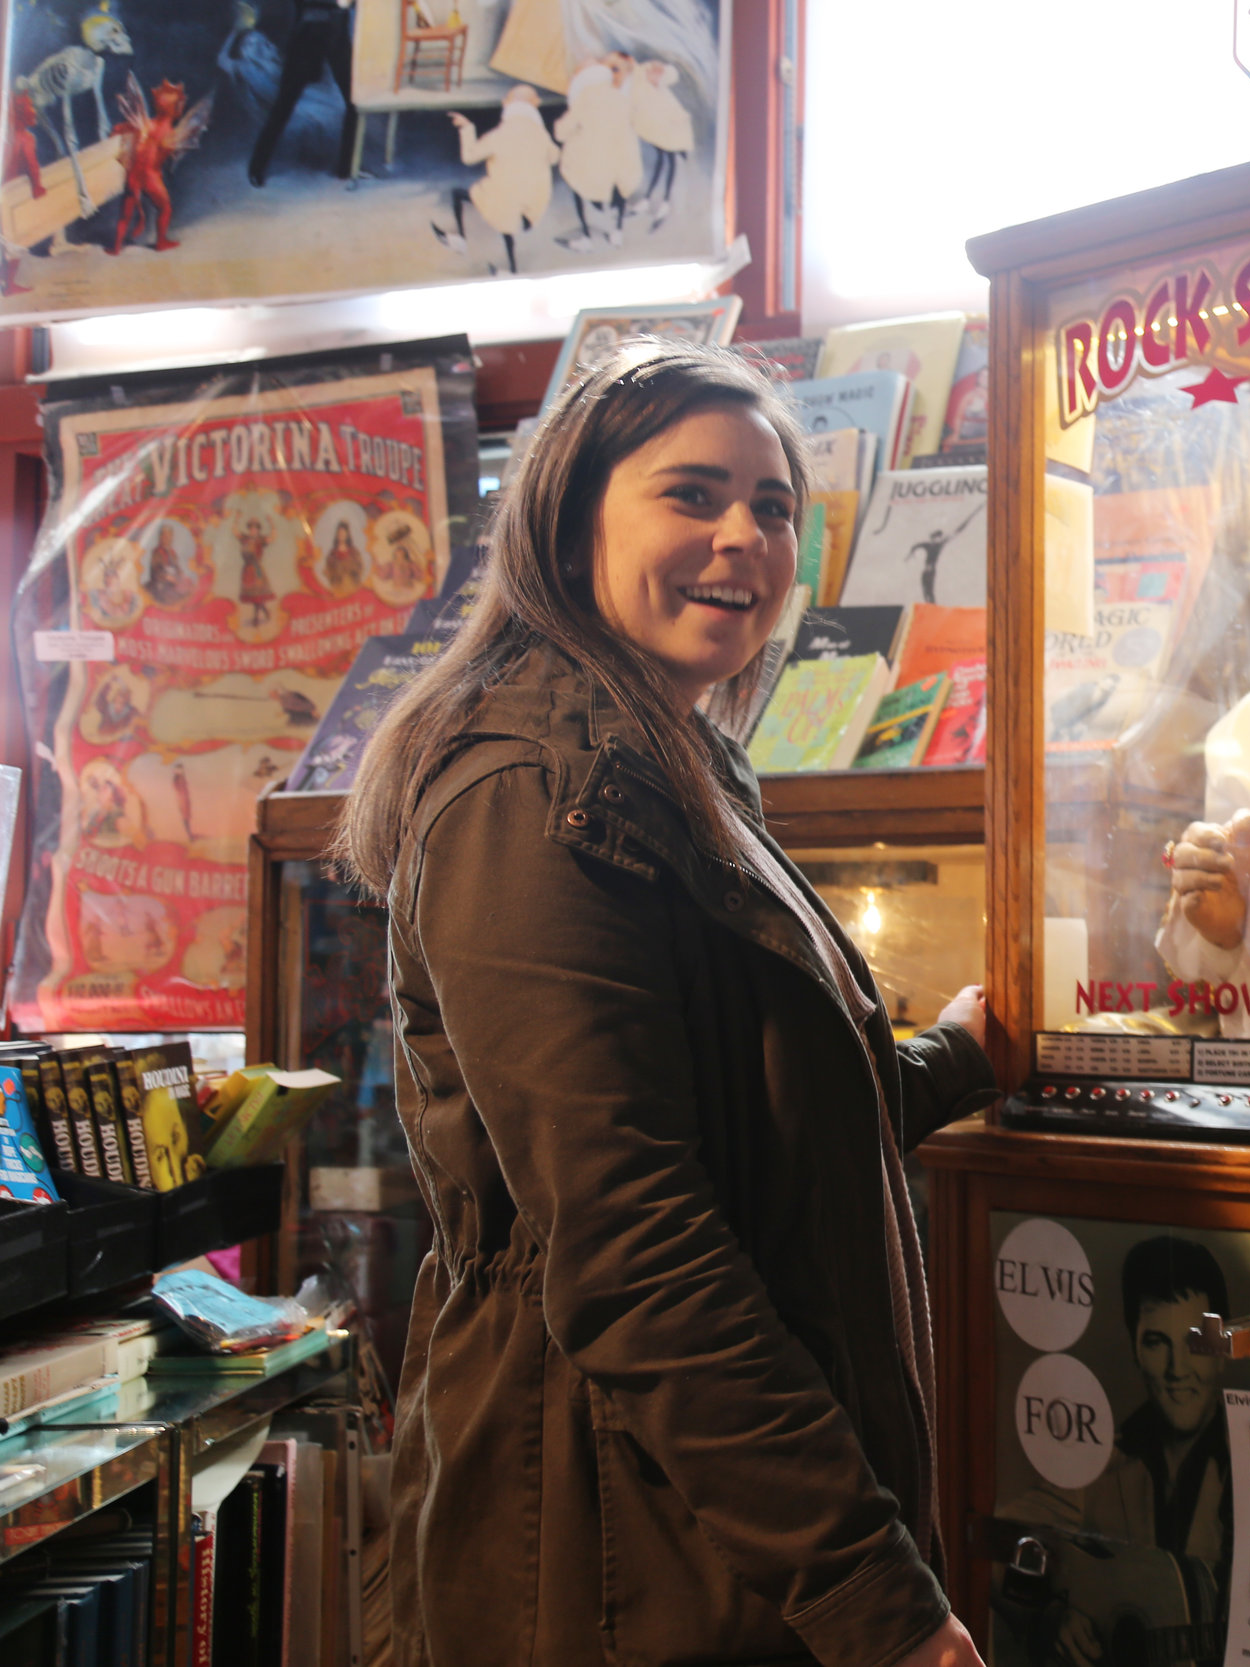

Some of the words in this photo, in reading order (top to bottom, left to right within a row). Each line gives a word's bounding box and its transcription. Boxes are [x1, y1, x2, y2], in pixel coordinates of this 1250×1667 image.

[1062, 266, 1214, 418] ROCK
[150, 421, 342, 498] VICTORINA
[340, 424, 425, 492] TROUPE
[1094, 606, 1151, 628] AGIC
[151, 866, 187, 896] GUN
[188, 870, 248, 899] BARRE
[1075, 979, 1156, 1015] NEXT
[142, 1065, 190, 1091] HOUDINI
[126, 1117, 153, 1189] HOUDIN
[997, 1258, 1095, 1307] ELVIS
[1023, 1395, 1103, 1446] FOR
[199, 1548, 213, 1637] History
